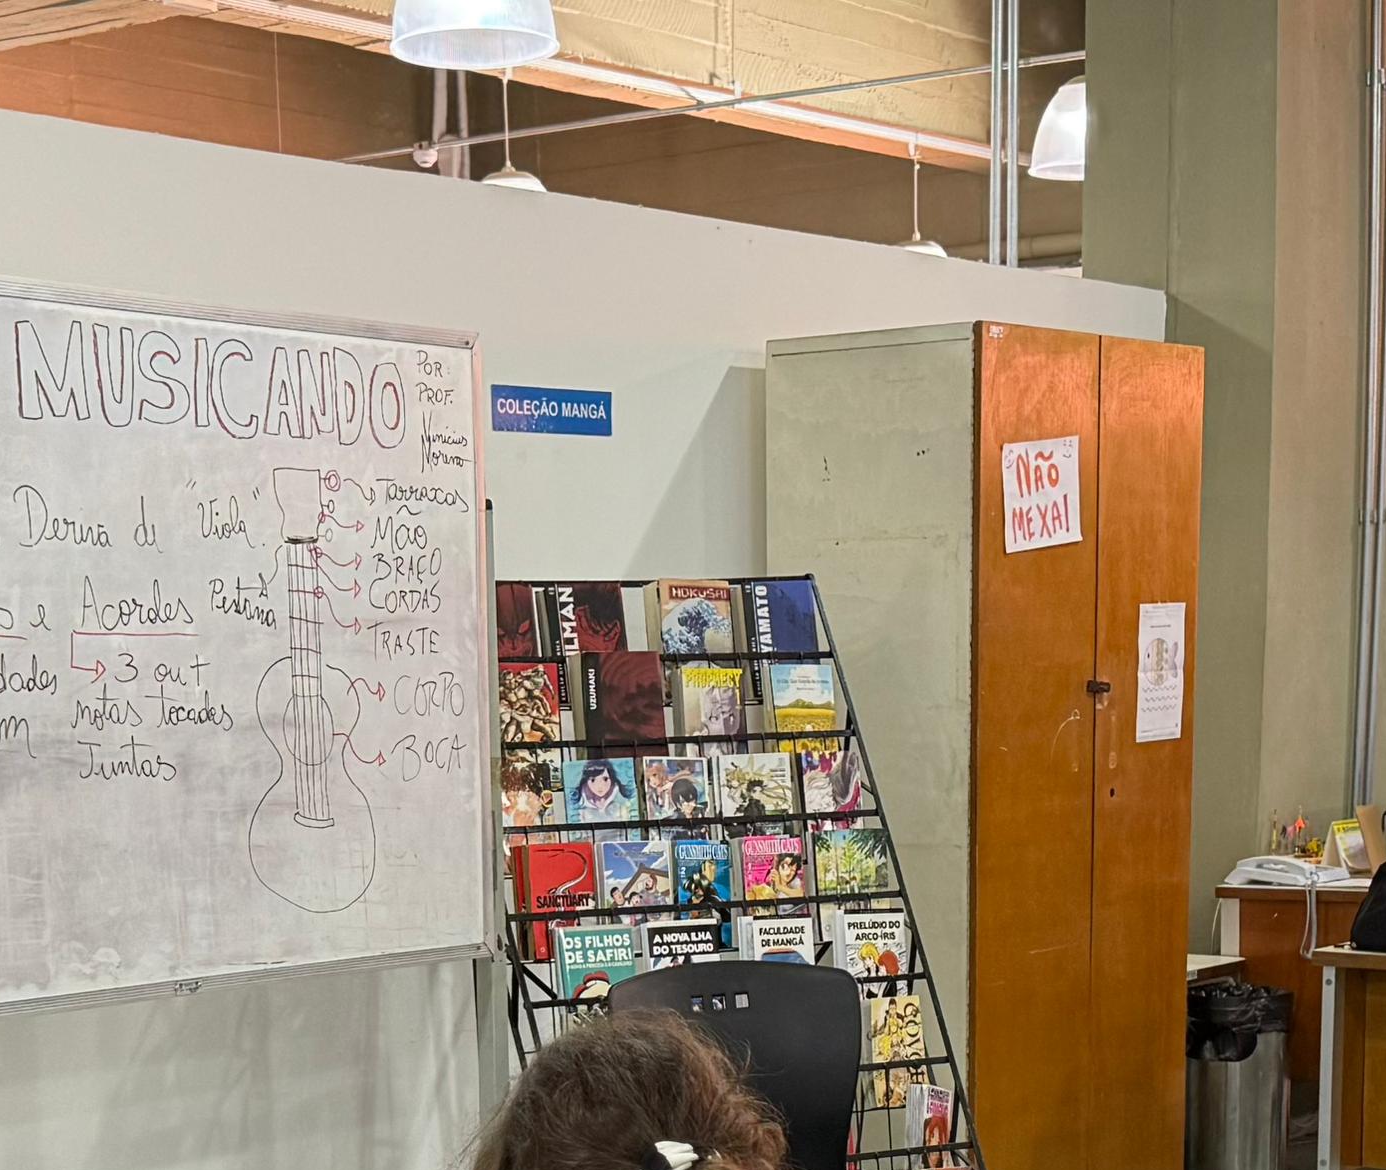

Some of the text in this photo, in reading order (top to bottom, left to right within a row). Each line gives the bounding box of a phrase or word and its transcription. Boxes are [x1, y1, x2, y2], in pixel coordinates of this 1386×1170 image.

[15, 320, 406, 449] MUSICANDO
[415, 382, 455, 405] PROF.
[497, 397, 606, 420] COLEÇÃO MANGÁ
[1016, 448, 1059, 498] NÃO
[1013, 493, 1070, 544] MEXA!
[373, 547, 442, 585] BRAÇO
[29, 603, 52, 632] e
[81, 575, 195, 631] Acordes
[369, 577, 441, 614] CORDAS
[673, 587, 727, 599] HOKUSAI
[367, 620, 441, 661] TRASTE
[114, 652, 138, 683] 3
[154, 663, 187, 686] ou
[394, 671, 465, 717] CORPO
[588, 668, 597, 710] UZUMAKI
[77, 735, 177, 781] Juntas
[391, 734, 467, 782] BOCA
[536, 893, 590, 909] SANCTUARY
[653, 931, 712, 944] A NOVA ILHA
[759, 926, 805, 936] FACULDADE
[848, 919, 900, 930] PRELÚDIO DO
[855, 930, 896, 941] ARCO-ÍRIS
[564, 934, 631, 949] OS FILHOS
[653, 943, 714, 955] DO TESOURO
[762, 935, 804, 947] DE MANGÁ
[565, 952, 585, 964] DE
